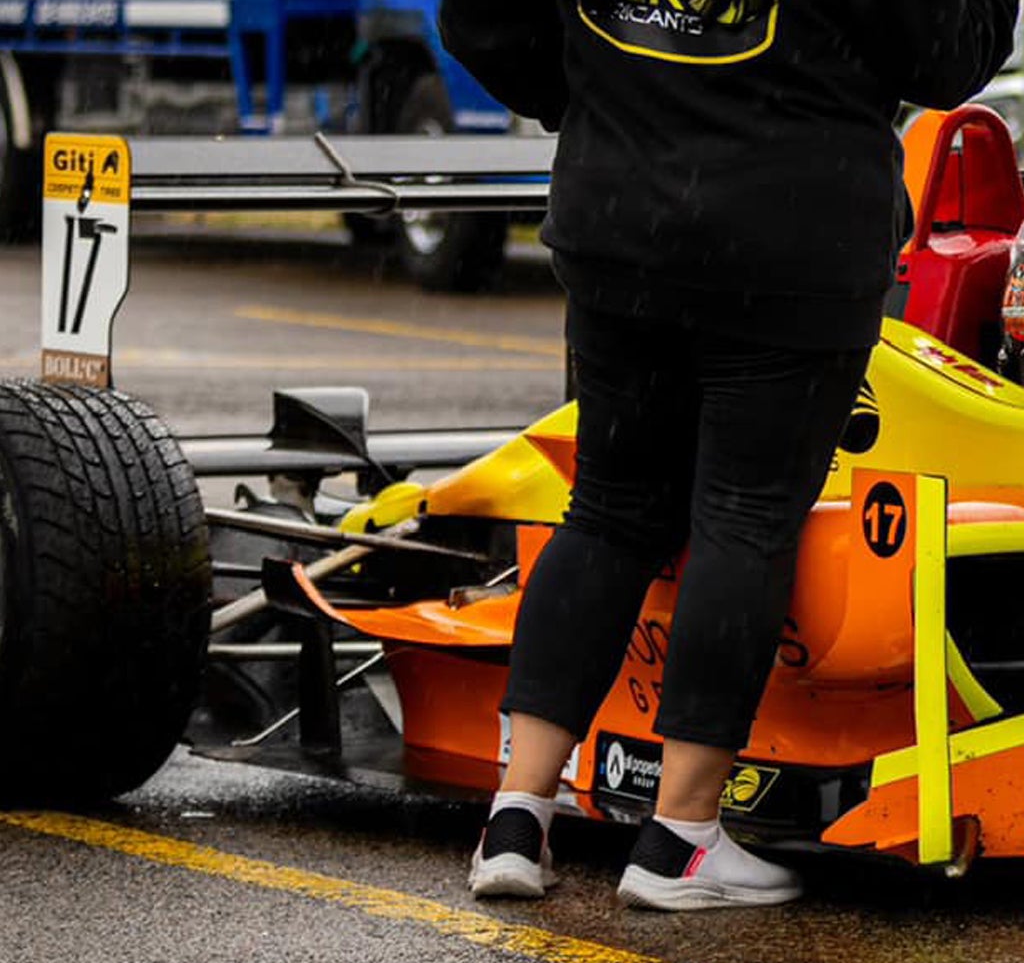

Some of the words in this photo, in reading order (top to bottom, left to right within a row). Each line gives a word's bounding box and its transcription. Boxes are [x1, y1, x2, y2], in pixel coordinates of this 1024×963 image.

[53, 149, 95, 173] Giti
[57, 215, 118, 334] 17
[864, 502, 904, 546] 17
